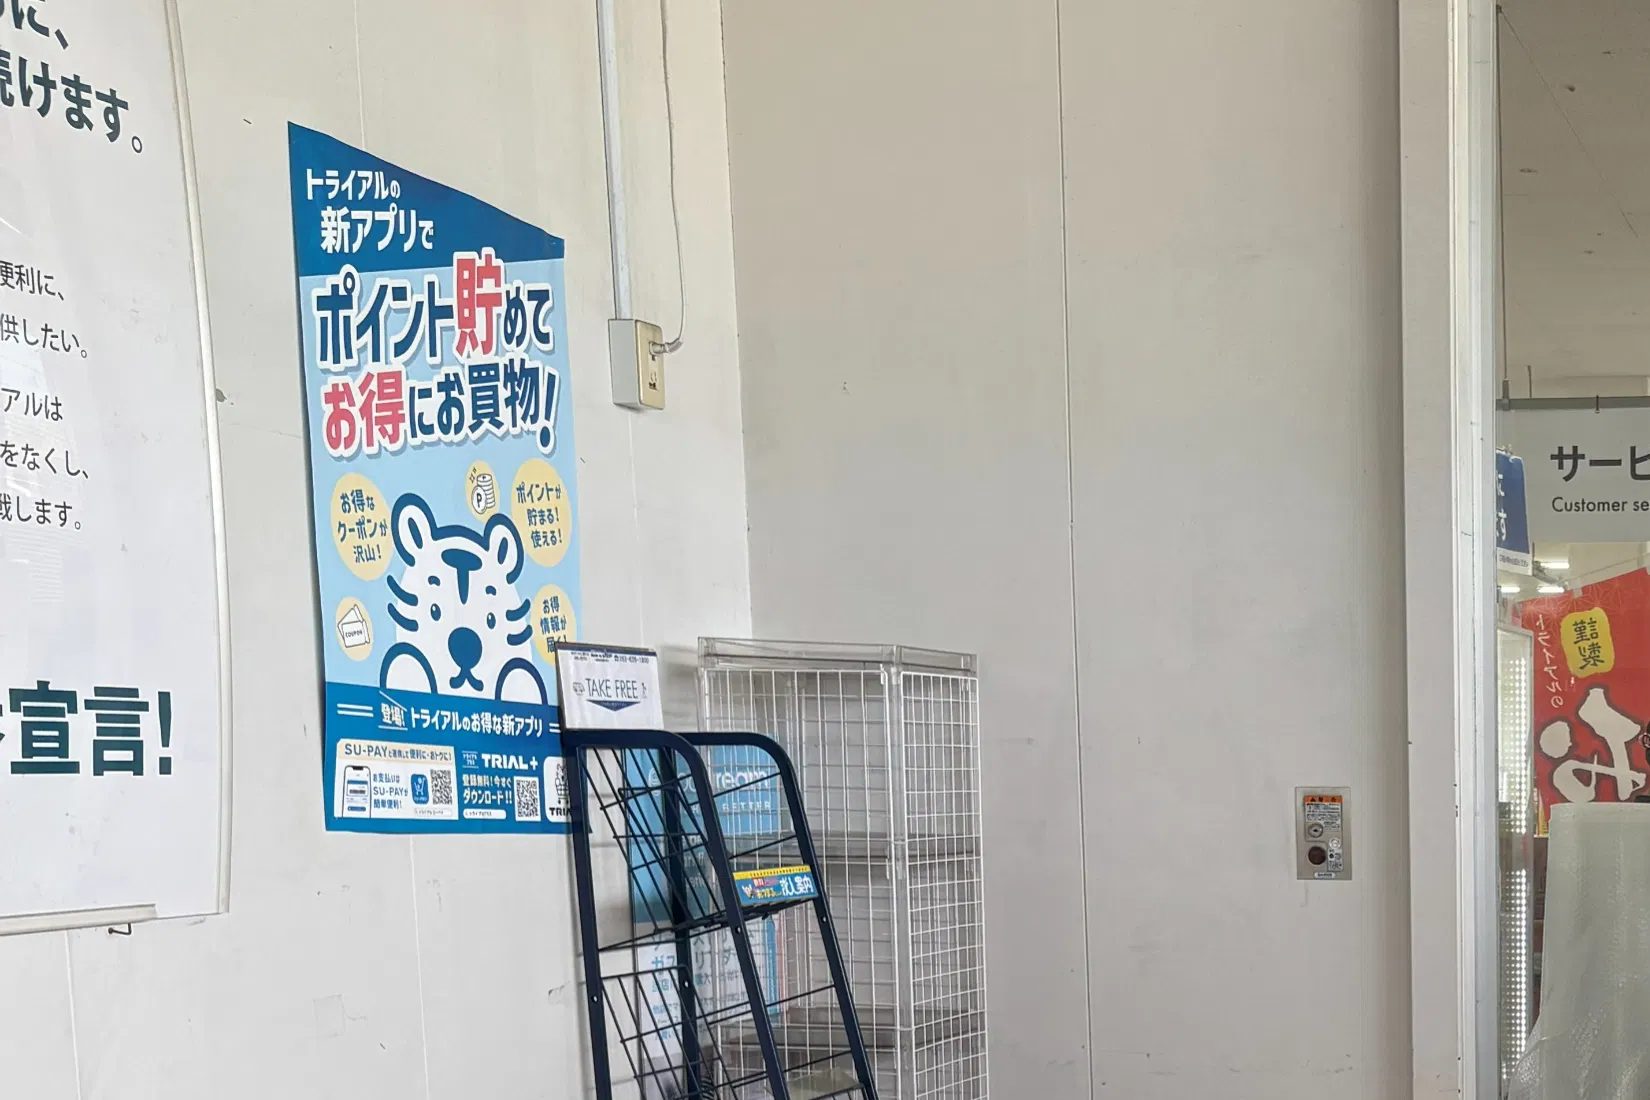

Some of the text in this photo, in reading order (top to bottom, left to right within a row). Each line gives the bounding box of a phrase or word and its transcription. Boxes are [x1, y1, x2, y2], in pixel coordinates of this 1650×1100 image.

[0, 0, 69, 50] に、
[306, 168, 400, 200] トライアルの
[321, 203, 434, 254] 新アプリで
[316, 254, 552, 366] ポイント貯めて
[0, 313, 88, 359] 供したい。
[324, 358, 560, 450] お得にお買物!
[340, 489, 375, 514] お得な
[516, 481, 562, 504] ポイントが
[1552, 496, 1627, 512] Customer
[338, 515, 388, 542] クーポンが
[527, 507, 559, 526] 貯まる!
[531, 529, 562, 548] 使える!
[353, 544, 381, 563] 沢山!
[543, 596, 560, 614] お得
[540, 616, 566, 635] 情報が
[585, 678, 638, 699] TAKE FREE
[381, 703, 405, 727] 登場!
[411, 707, 543, 738] トライアルのお得な新アプリ
[0, 679, 172, 777] 宣言!
